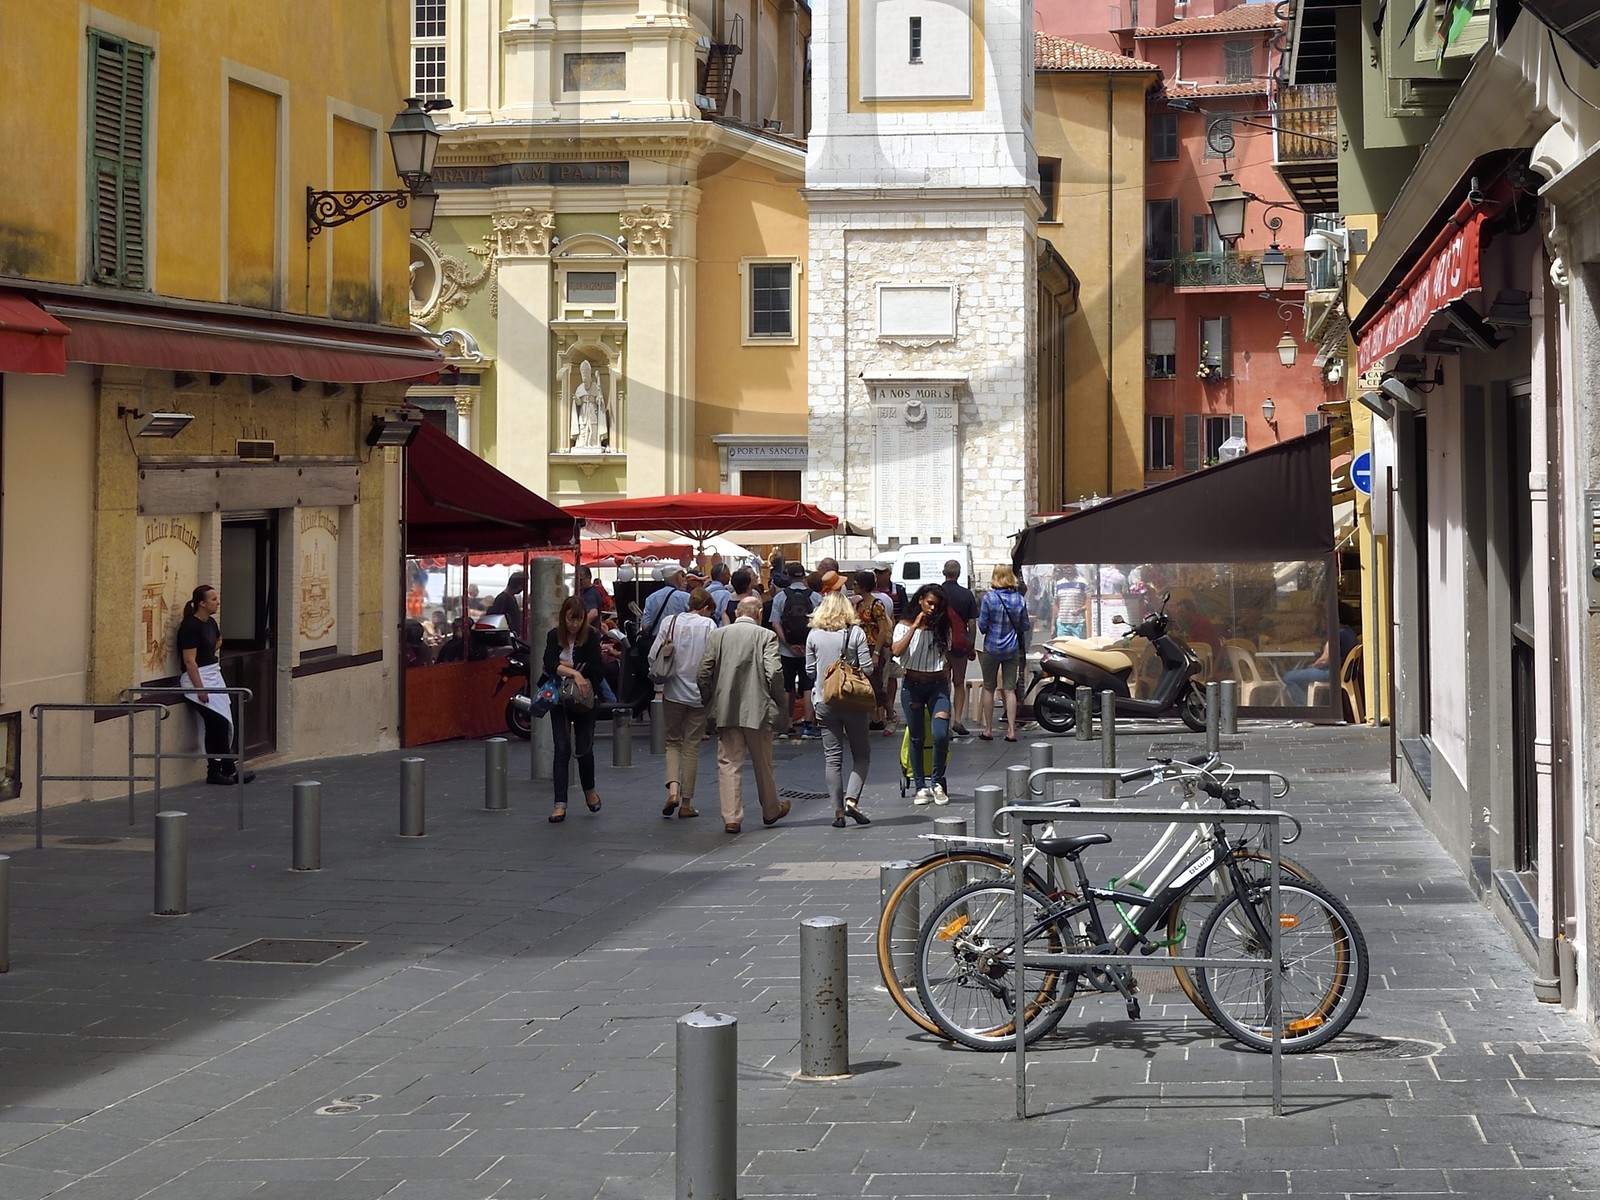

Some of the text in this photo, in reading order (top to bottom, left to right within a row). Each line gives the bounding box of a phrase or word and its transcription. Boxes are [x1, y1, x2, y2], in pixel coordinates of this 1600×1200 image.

[879, 389, 886, 398] A
[890, 389, 911, 399] NOS
[737, 447, 805, 455] PORTA SANCTA
